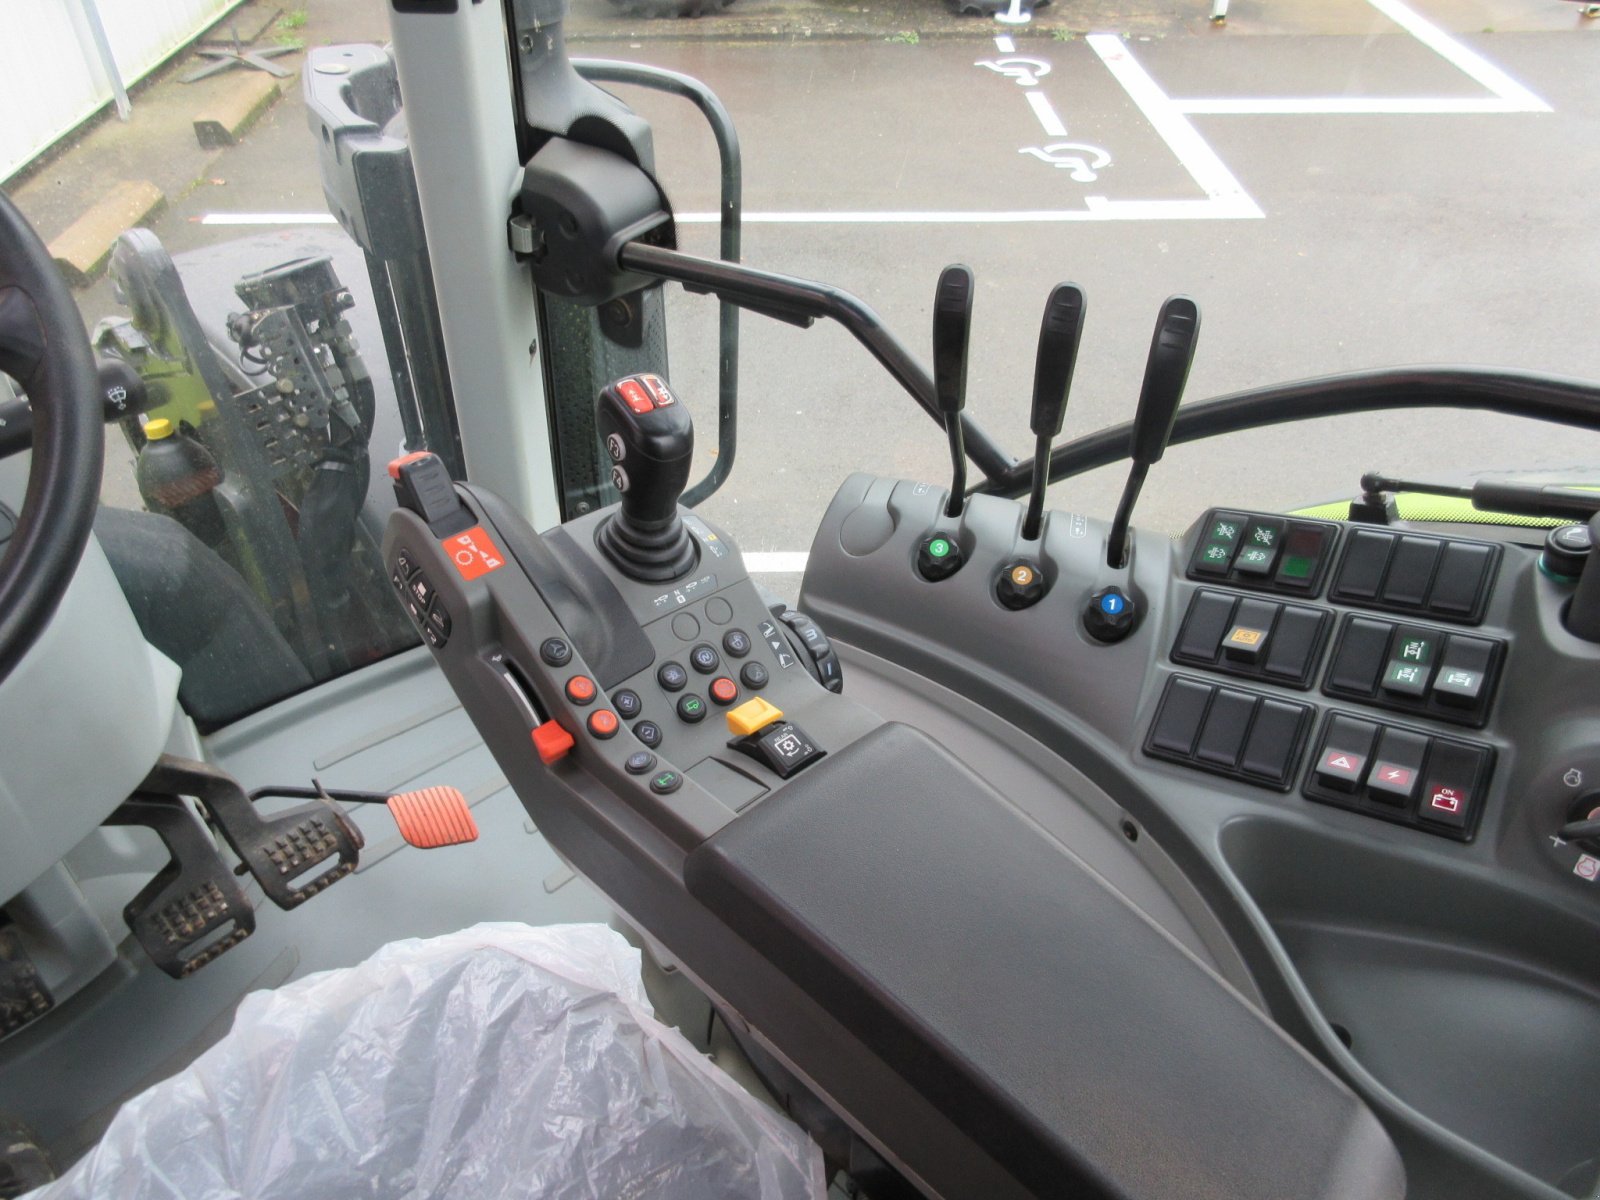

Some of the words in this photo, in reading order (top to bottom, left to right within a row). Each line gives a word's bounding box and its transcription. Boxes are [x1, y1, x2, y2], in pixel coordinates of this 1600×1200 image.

[608, 439, 620, 458] F3
[612, 470, 622, 489] F4
[935, 543, 943, 553] 3
[1017, 571, 1026, 582] 2
[412, 584, 426, 604] STOP
[1109, 598, 1116, 610] 1
[774, 733, 789, 743] REAR
[1441, 787, 1455, 796] ON
